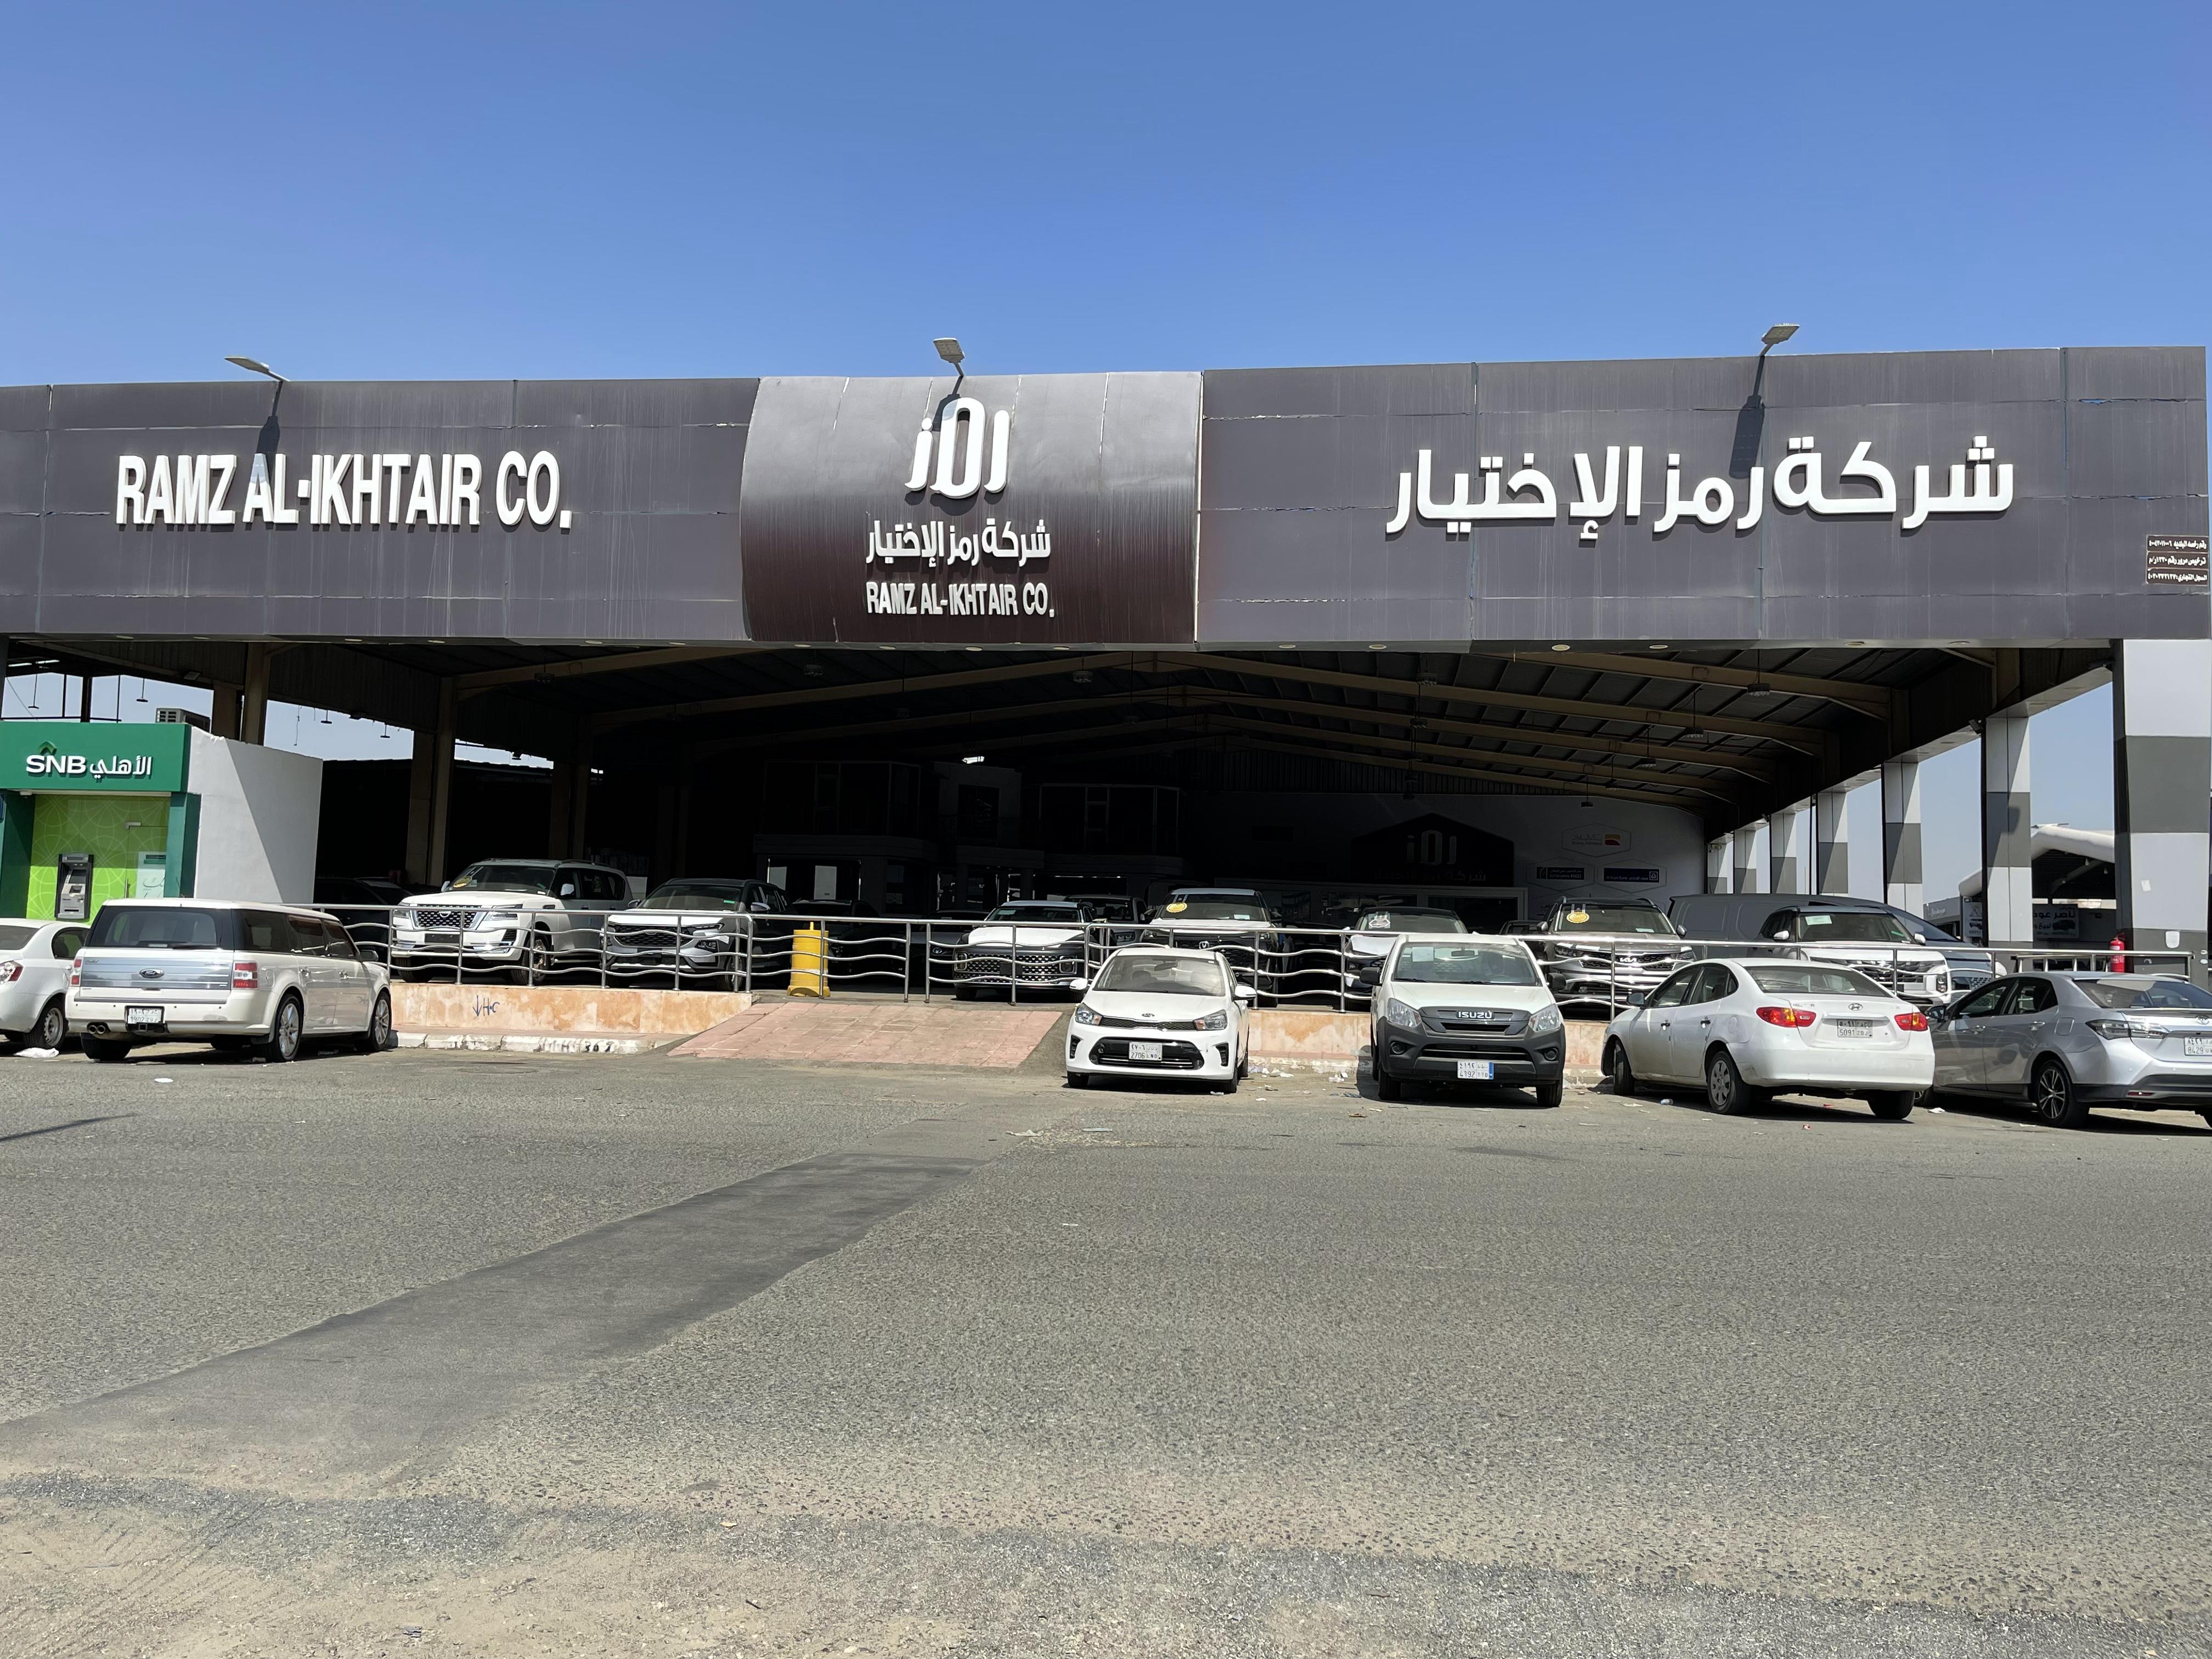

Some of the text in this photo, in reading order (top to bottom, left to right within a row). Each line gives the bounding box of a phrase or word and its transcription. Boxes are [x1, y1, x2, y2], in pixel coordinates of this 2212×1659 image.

[116, 450, 572, 529] RAMZ AL-IKHTAIR CO.
[1385, 435, 2015, 540] شركة رمز الإختيار
[866, 517, 1051, 567] شركة رمز الإختيار
[866, 582, 1055, 618] RAMZ AL-IKHTAIR CO.
[26, 754, 87, 774] SNB
[89, 755, 153, 779] الأهلي
[1458, 1011, 1492, 1019] ISUZU
